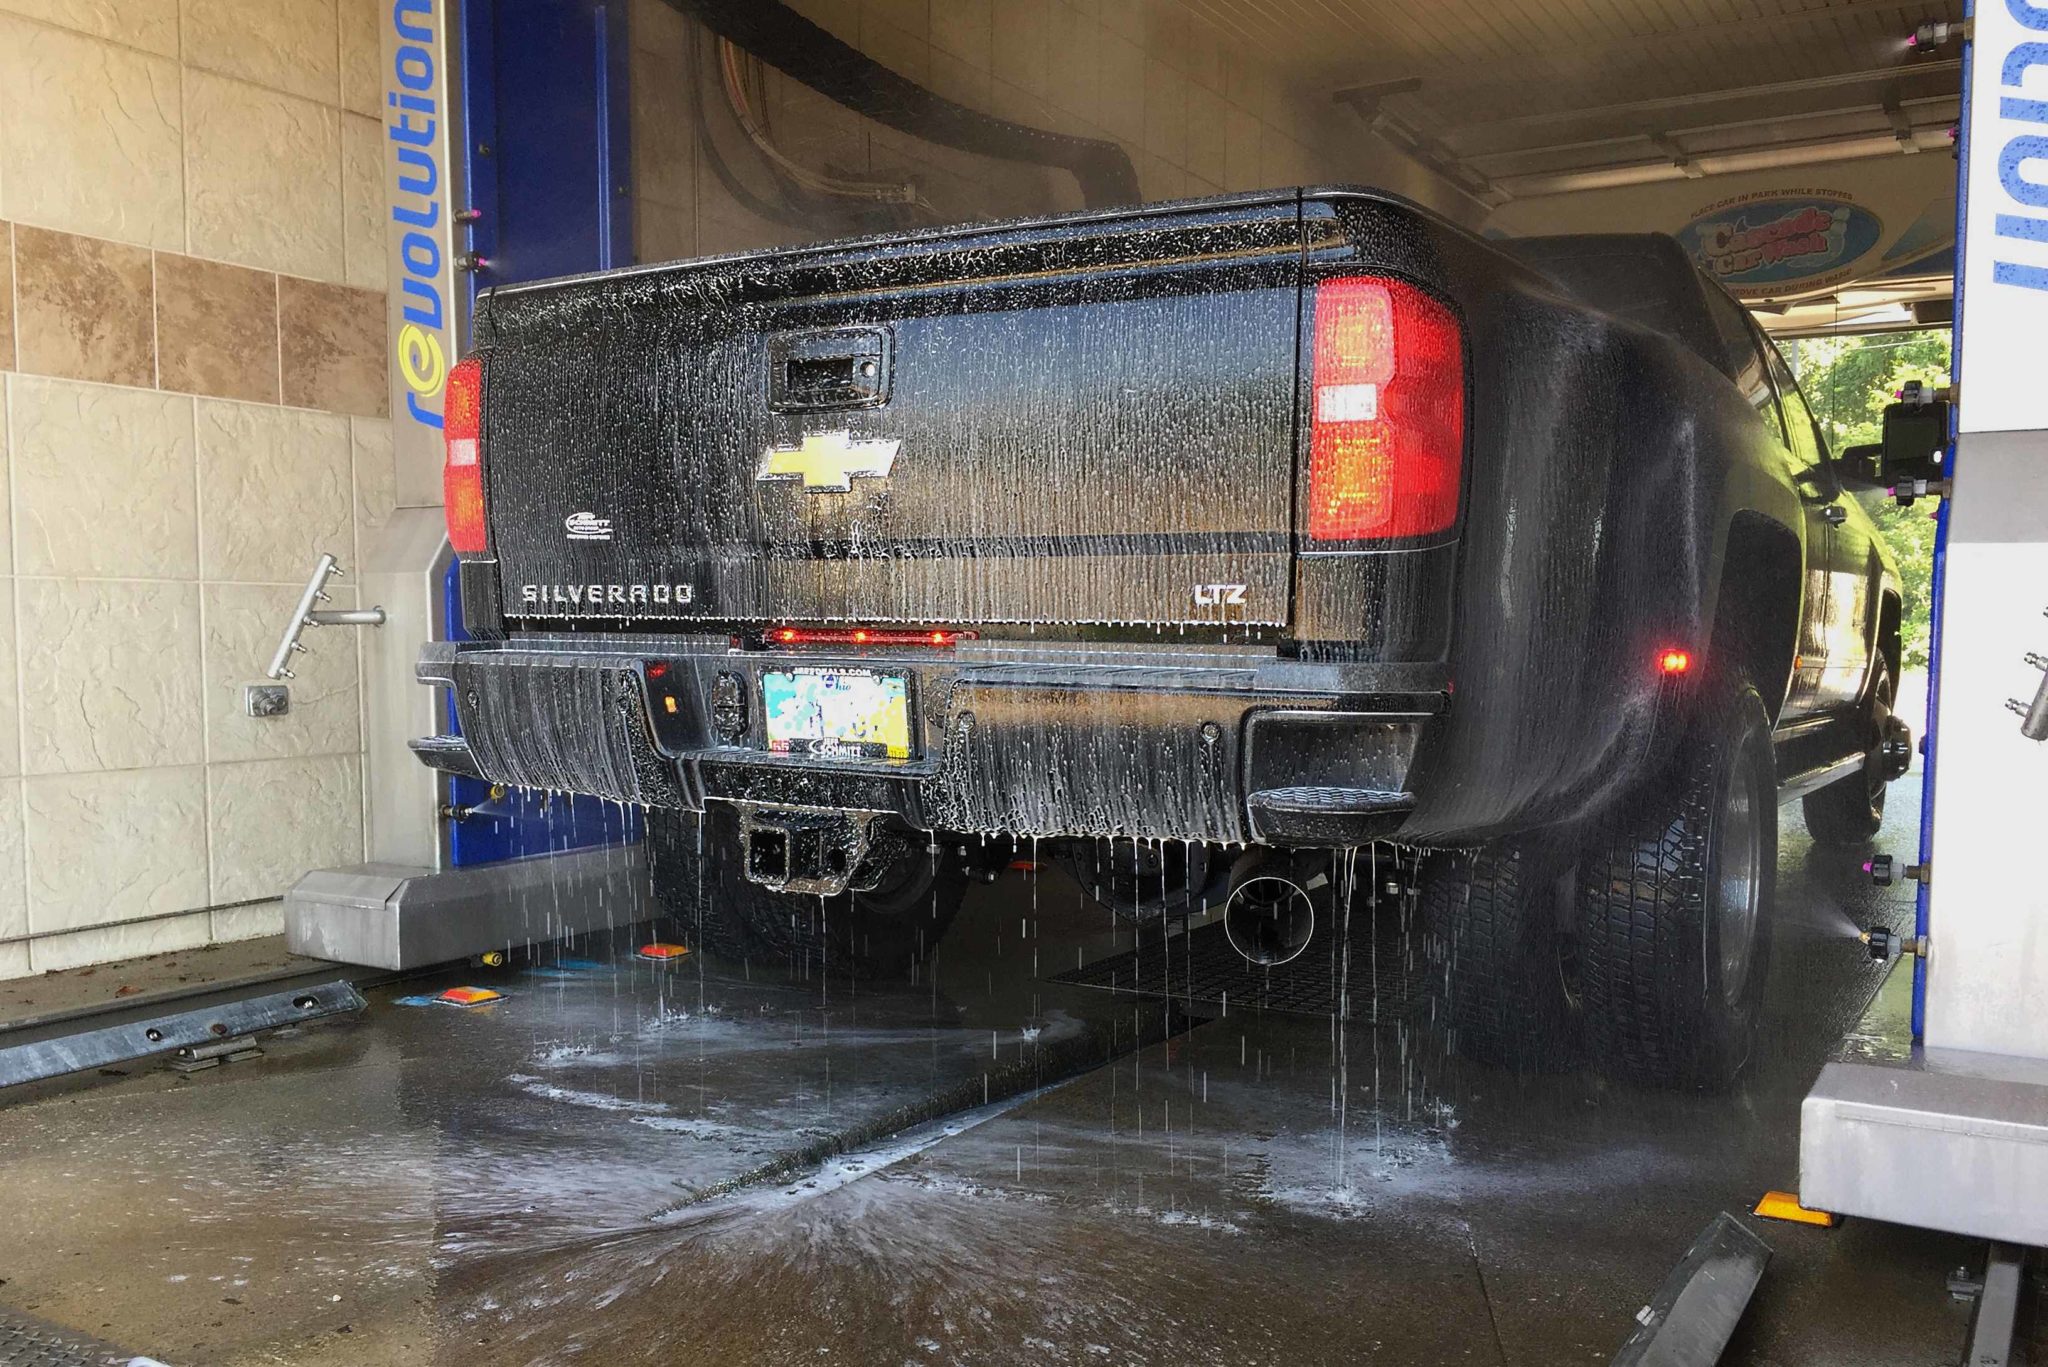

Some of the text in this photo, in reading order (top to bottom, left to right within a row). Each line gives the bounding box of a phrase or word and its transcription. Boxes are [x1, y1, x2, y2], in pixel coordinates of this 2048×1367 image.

[1717, 197, 1736, 208] CAR
[1738, 194, 1749, 202] IN
[1751, 189, 1778, 199] PARK
[1781, 188, 1812, 196] WHILE
[389, 0, 444, 429] revolution
[1714, 233, 1828, 275] Car Wash
[1761, 286, 1782, 295] CAR
[1785, 278, 1824, 293] DURING
[522, 584, 692, 604] SILVERADO
[1195, 584, 1247, 604] LTZ
